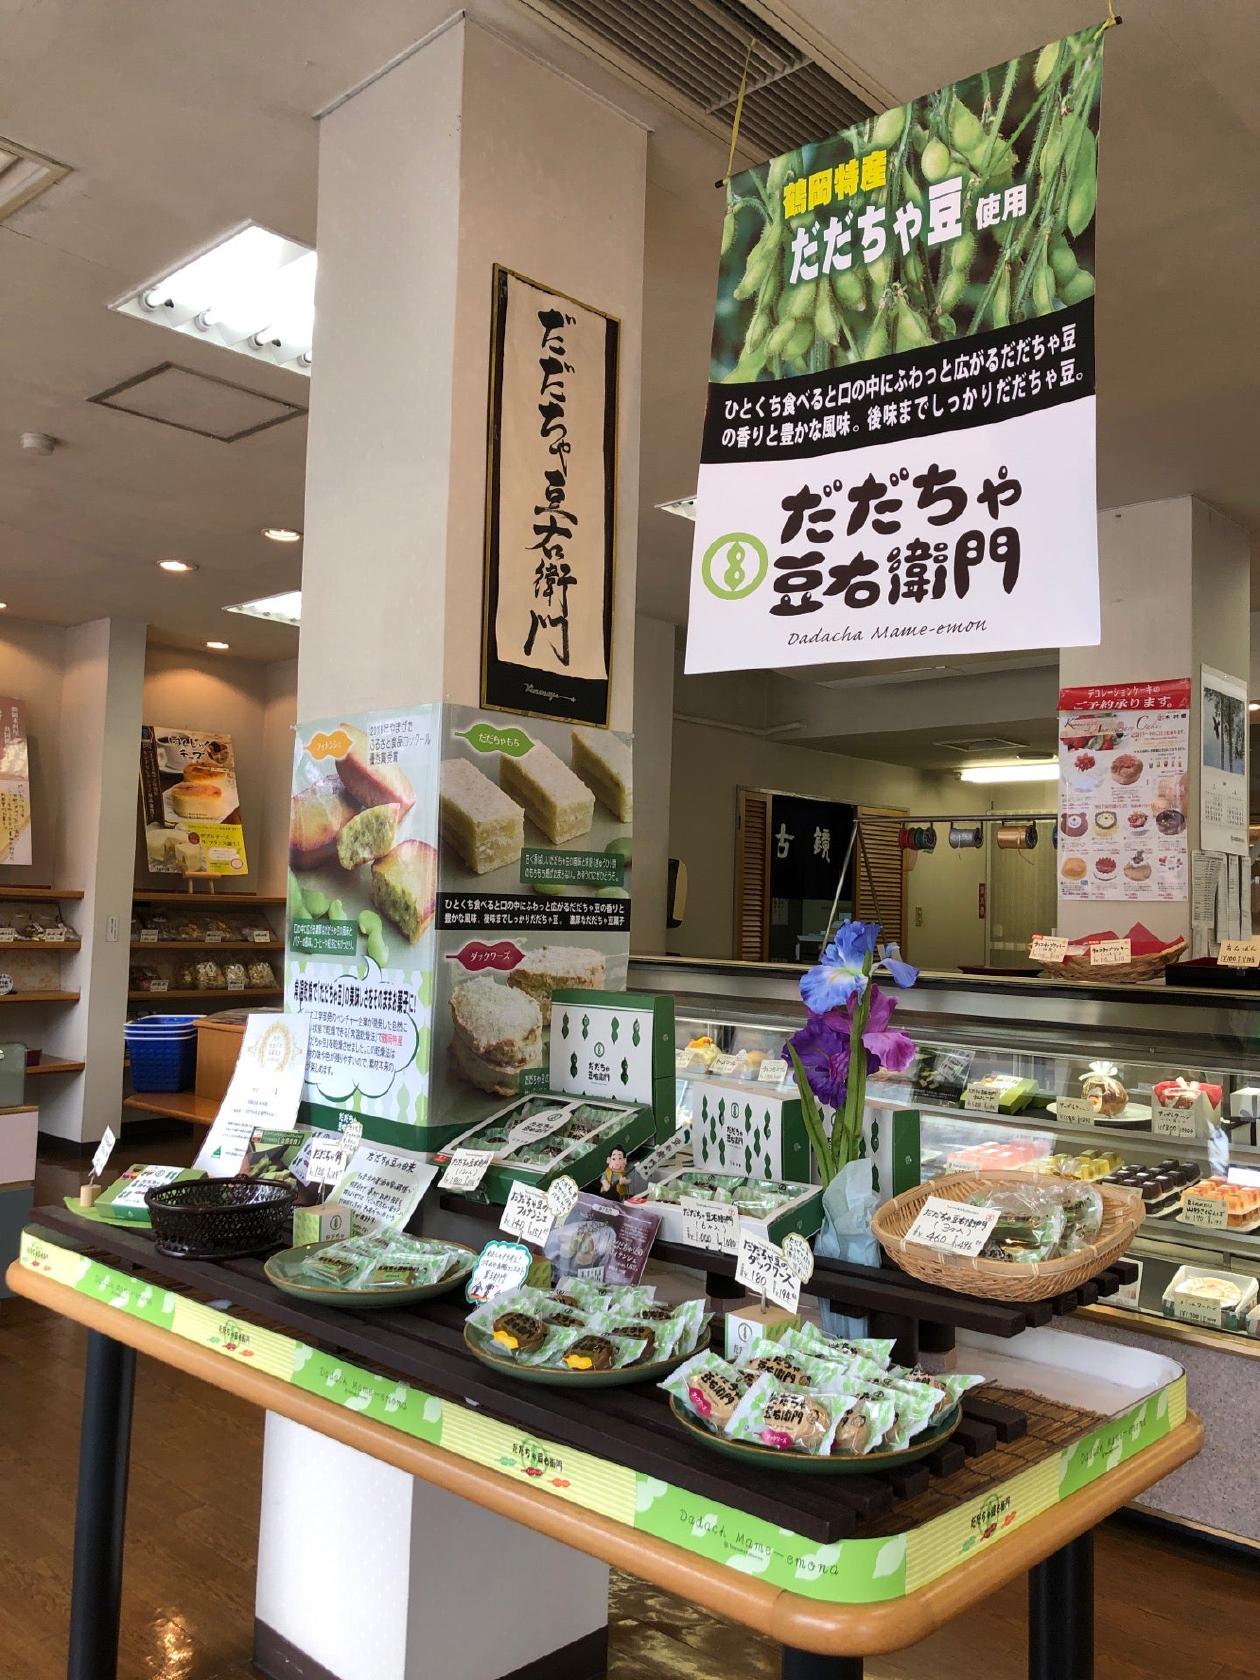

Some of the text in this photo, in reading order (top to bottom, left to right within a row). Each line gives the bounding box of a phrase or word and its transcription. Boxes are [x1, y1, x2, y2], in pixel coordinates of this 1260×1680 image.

[783, 149, 888, 219] 鶴岡特産
[788, 176, 1028, 285] だだちゃ豆 使用
[721, 358, 1085, 448] の香りと豊かな風味。後味までしっかりだだちゃ豆。
[724, 323, 1077, 421] ひとくち食べると口の中にふわっと広がるだだちゃ豆
[524, 307, 578, 667] だだちゃ豆右衛門
[780, 463, 1022, 545] だだちゃ
[769, 526, 1022, 617] 豆右衛門
[787, 617, 989, 647] Dadacha Mame-emon
[1073, 696, 1173, 710] ご予約承ります。
[1087, 684, 1161, 698] デコレーションケーキの
[470, 951, 512, 962] ダックワーズ
[763, 1405, 804, 1425] 豆右衛門
[679, 1508, 727, 1539] Dadach
